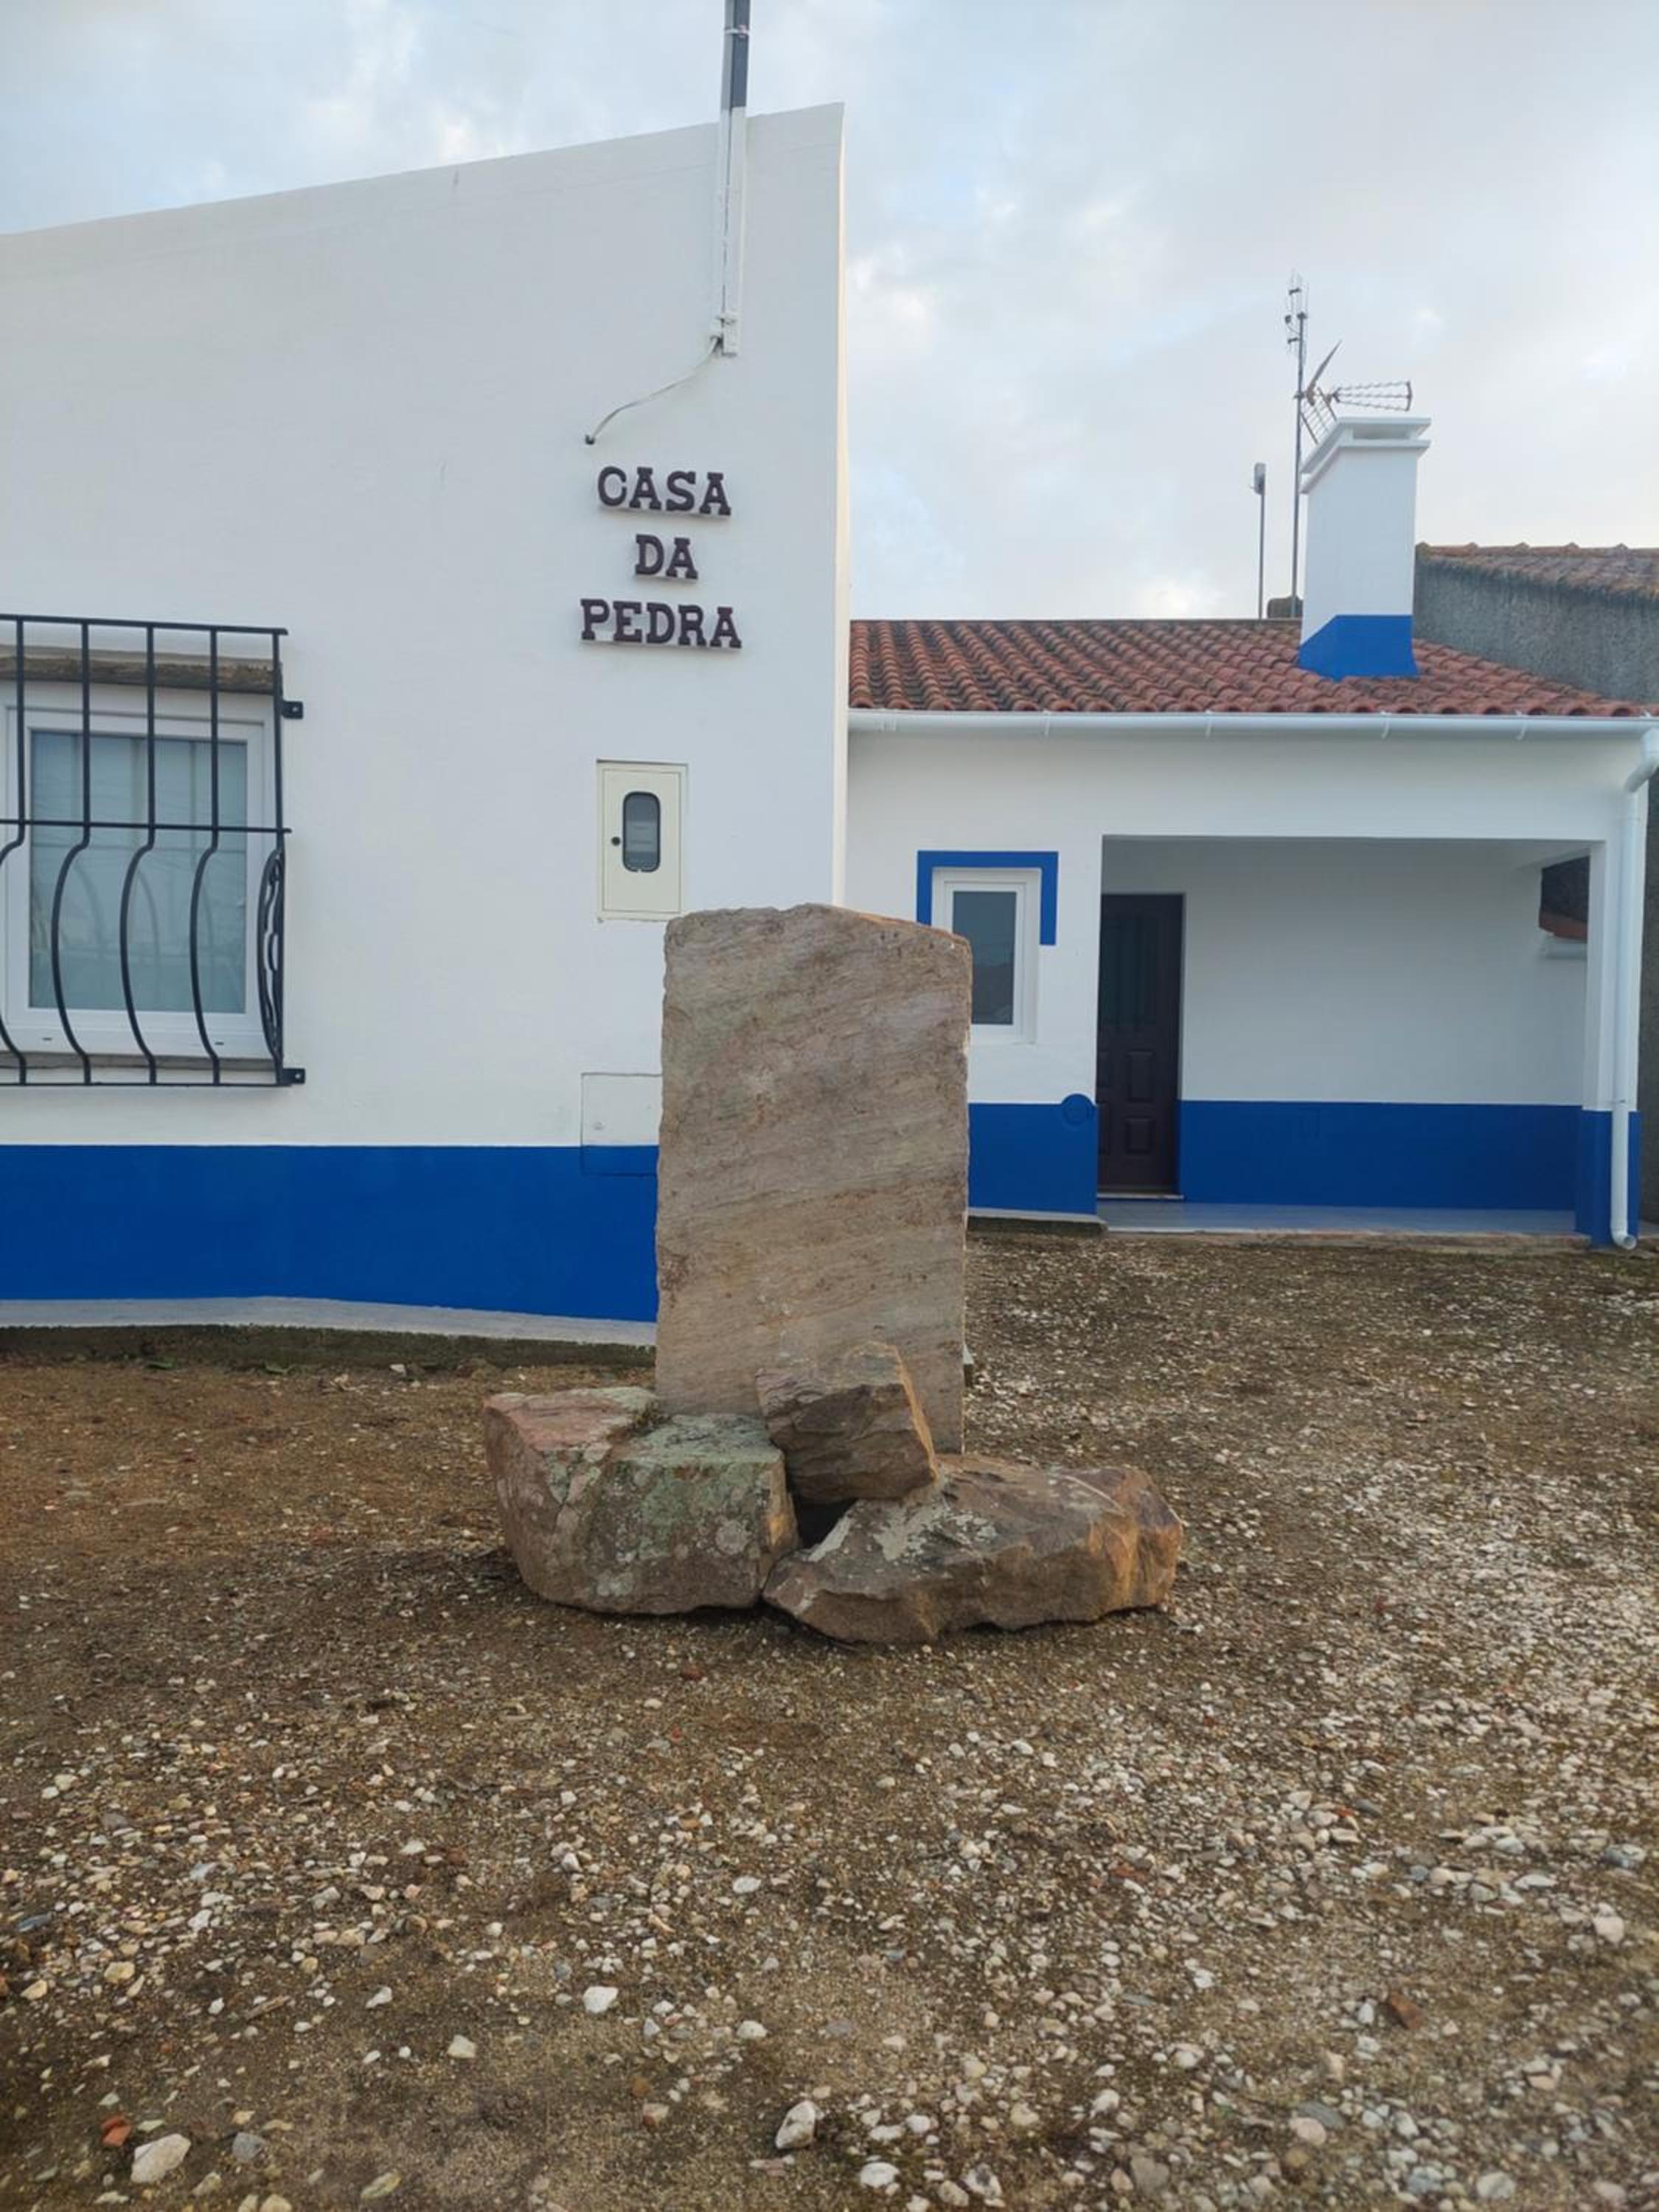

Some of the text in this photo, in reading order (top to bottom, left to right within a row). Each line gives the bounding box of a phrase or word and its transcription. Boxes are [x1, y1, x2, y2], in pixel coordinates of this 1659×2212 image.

[598, 466, 731, 516] CASA
[636, 534, 698, 580] DA
[581, 599, 741, 649] PEDRA
